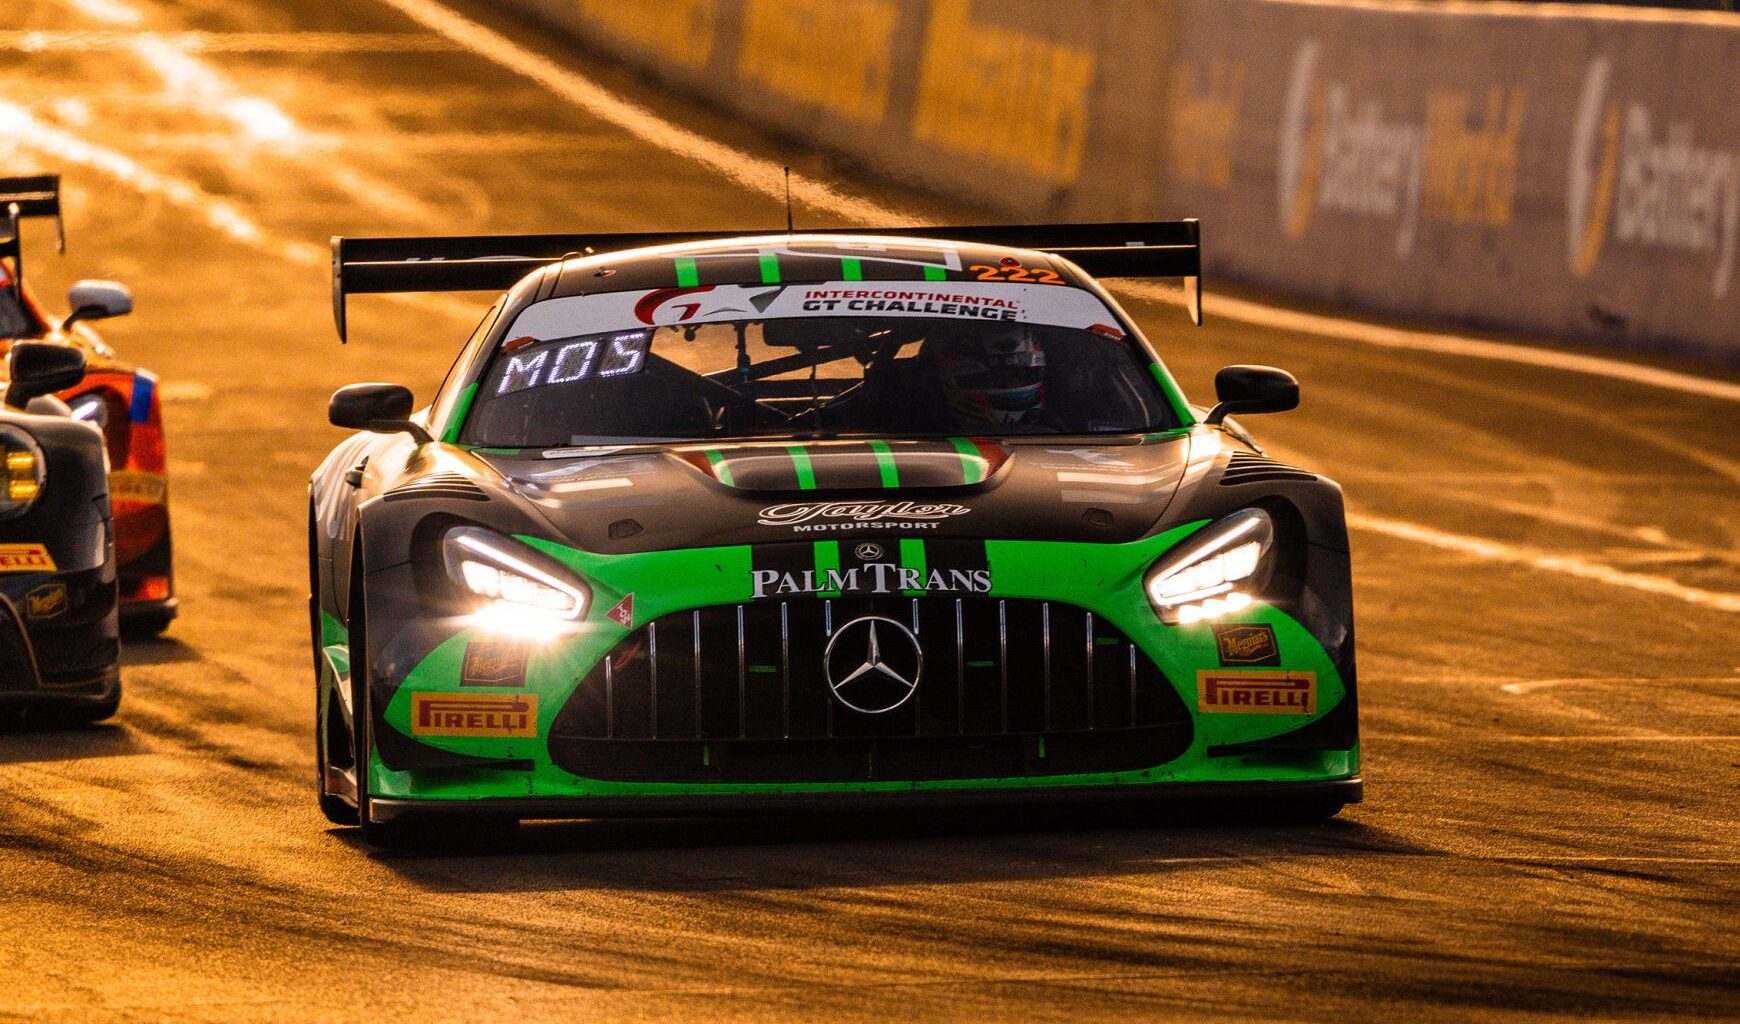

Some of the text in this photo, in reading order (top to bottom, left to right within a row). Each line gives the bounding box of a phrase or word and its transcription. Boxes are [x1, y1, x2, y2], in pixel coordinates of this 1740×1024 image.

[969, 264, 1066, 285] 222
[802, 298, 1018, 322] GT CHALLENGE
[804, 289, 1019, 309] INTERCONTINENTAL
[497, 332, 646, 395] MOS
[757, 500, 972, 526] Taylor
[793, 522, 941, 533] MOTORSPORT
[1205, 677, 1310, 707] PIRELLI
[419, 700, 530, 730] PIRELLI
